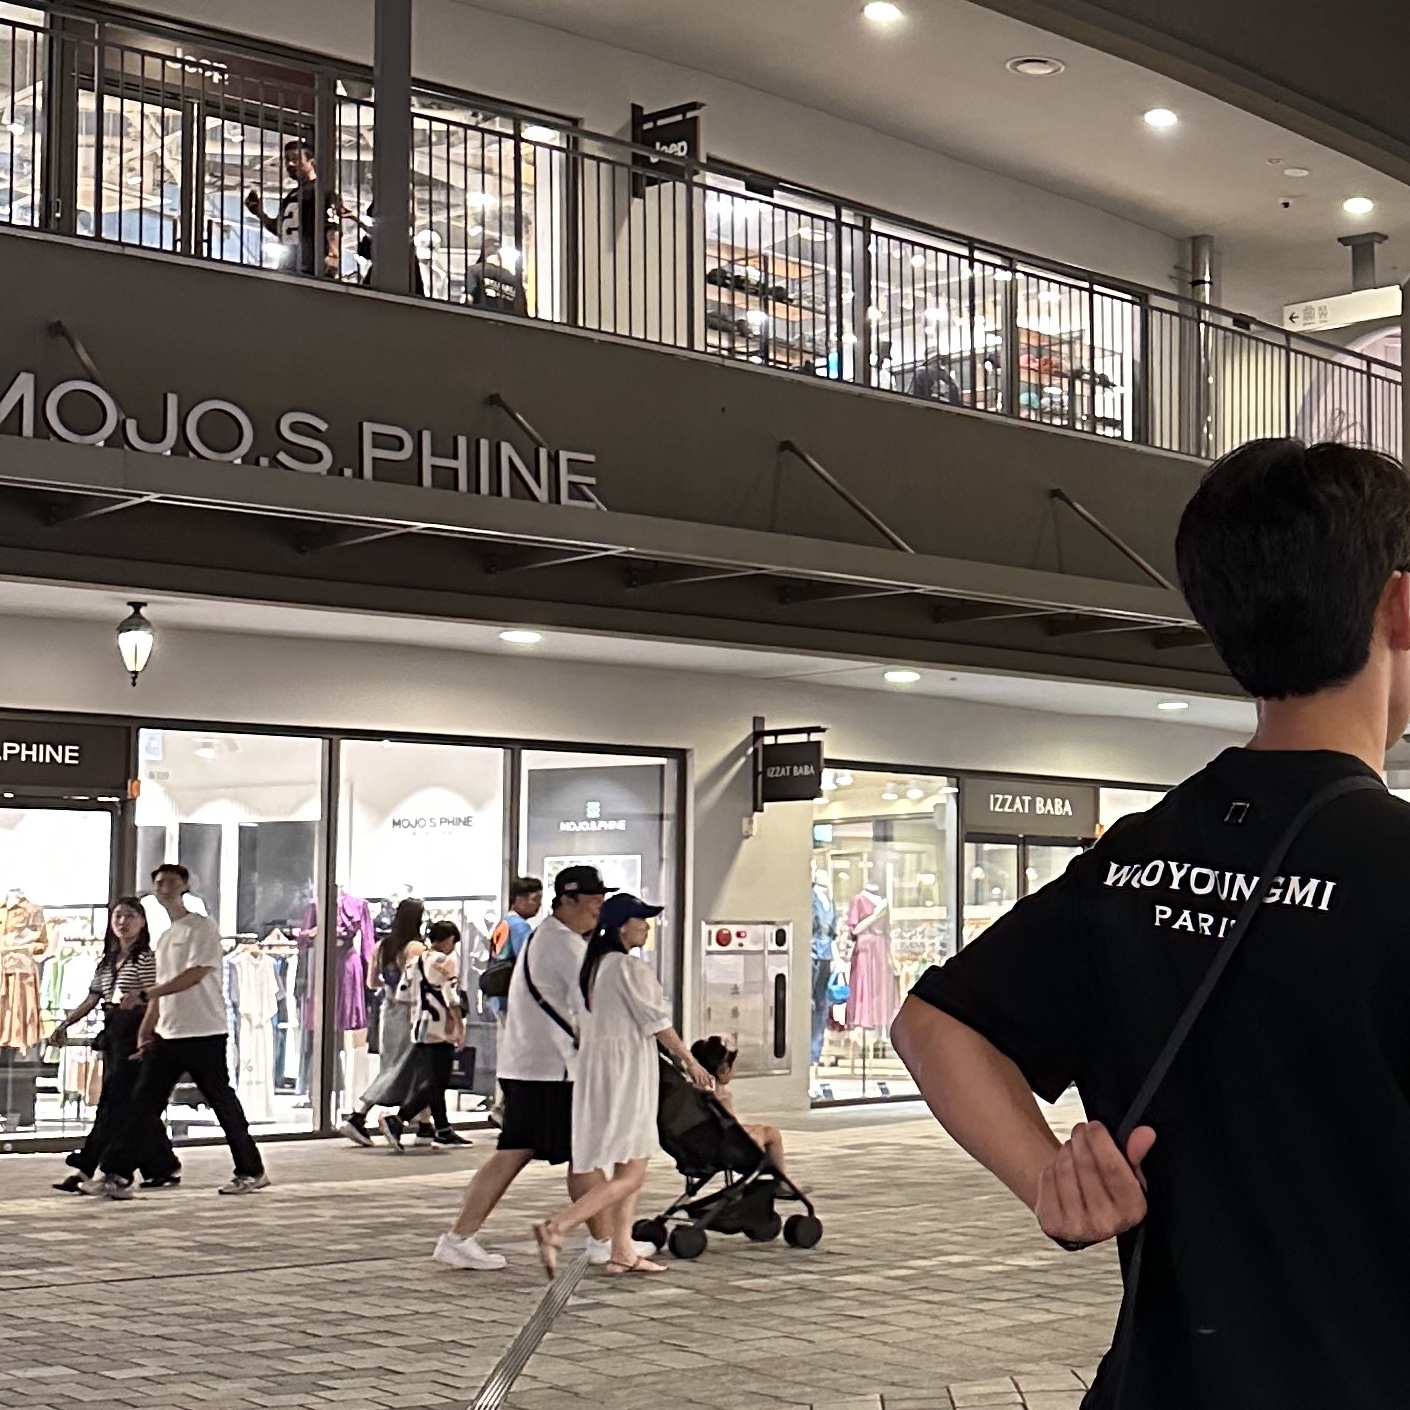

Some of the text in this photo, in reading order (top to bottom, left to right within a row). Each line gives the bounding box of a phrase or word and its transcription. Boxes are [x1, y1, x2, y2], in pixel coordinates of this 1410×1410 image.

[766, 765, 792, 778] IZZAT
[989, 793, 1073, 816] IZZAT BABA
[1154, 904, 1238, 939] PARI
